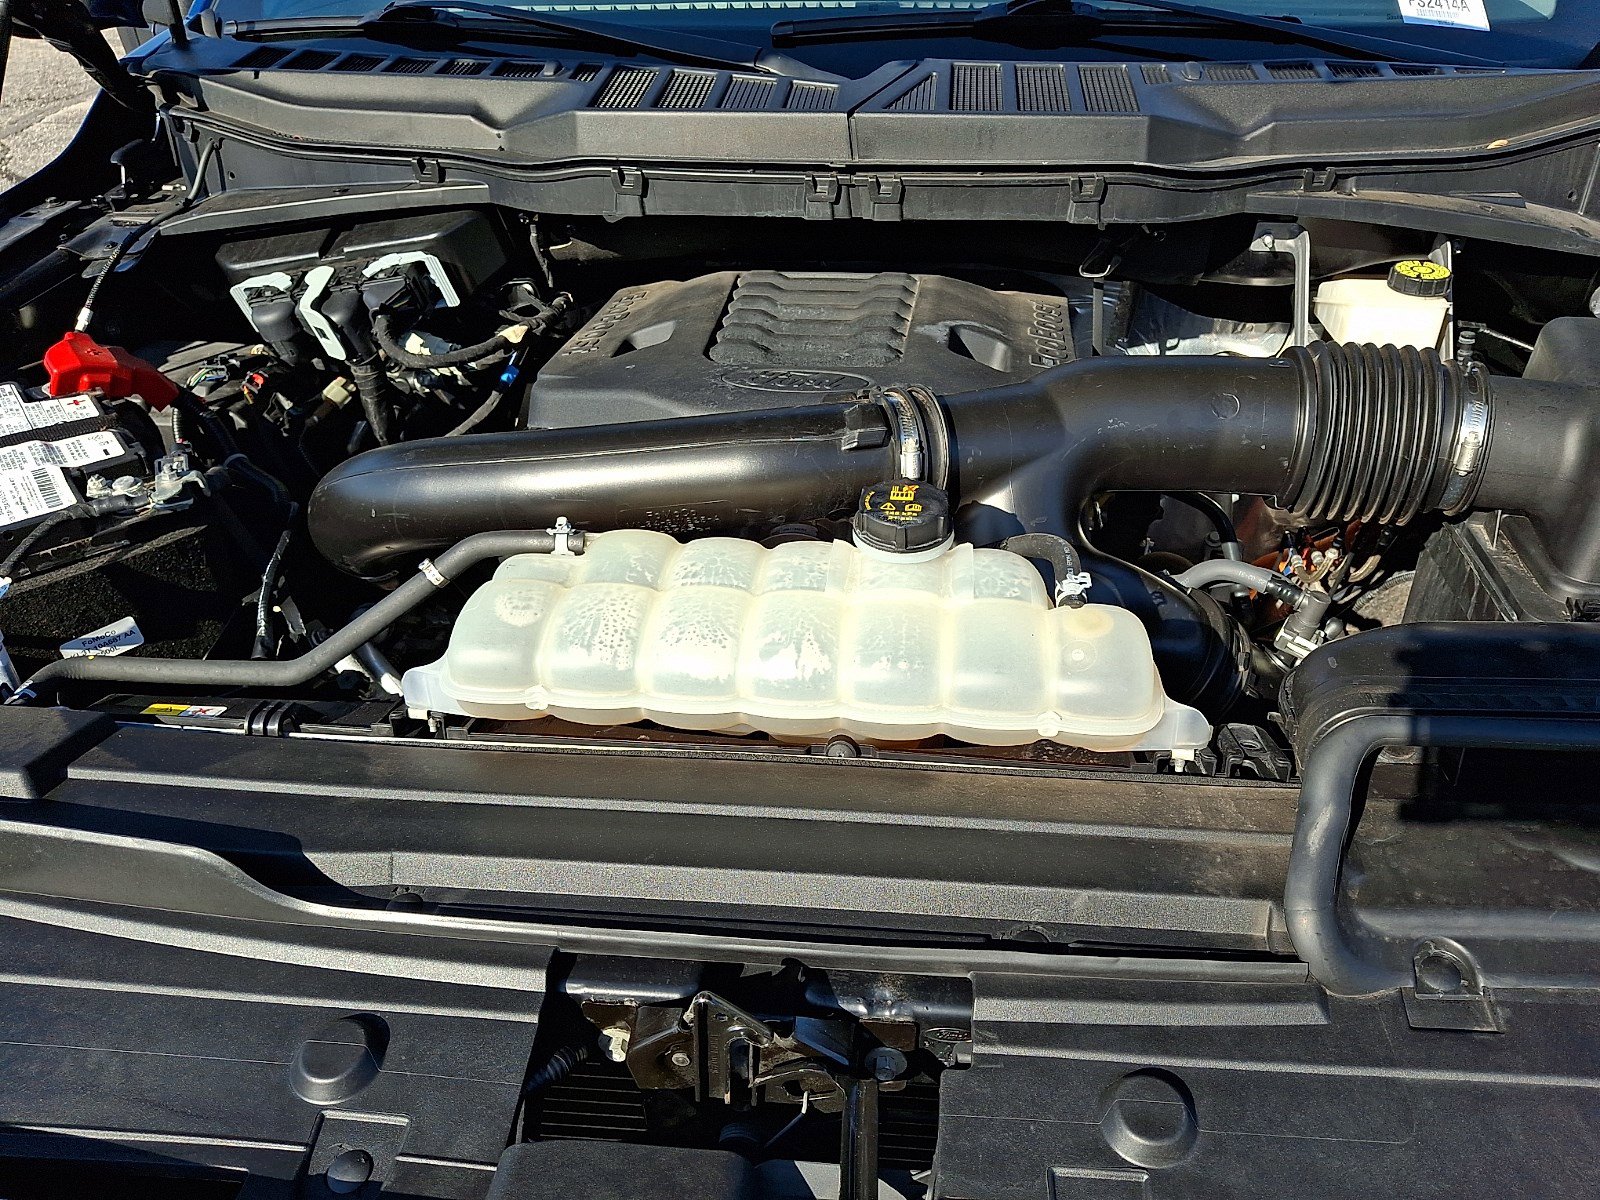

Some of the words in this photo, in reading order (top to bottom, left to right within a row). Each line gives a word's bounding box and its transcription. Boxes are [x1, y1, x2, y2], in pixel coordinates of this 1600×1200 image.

[562, 290, 649, 357] EcoBoost
[1025, 297, 1069, 369] EcoBoost
[746, 369, 847, 391] Ford
[82, 630, 116, 647] FoMoCo
[124, 630, 136, 638] AA
